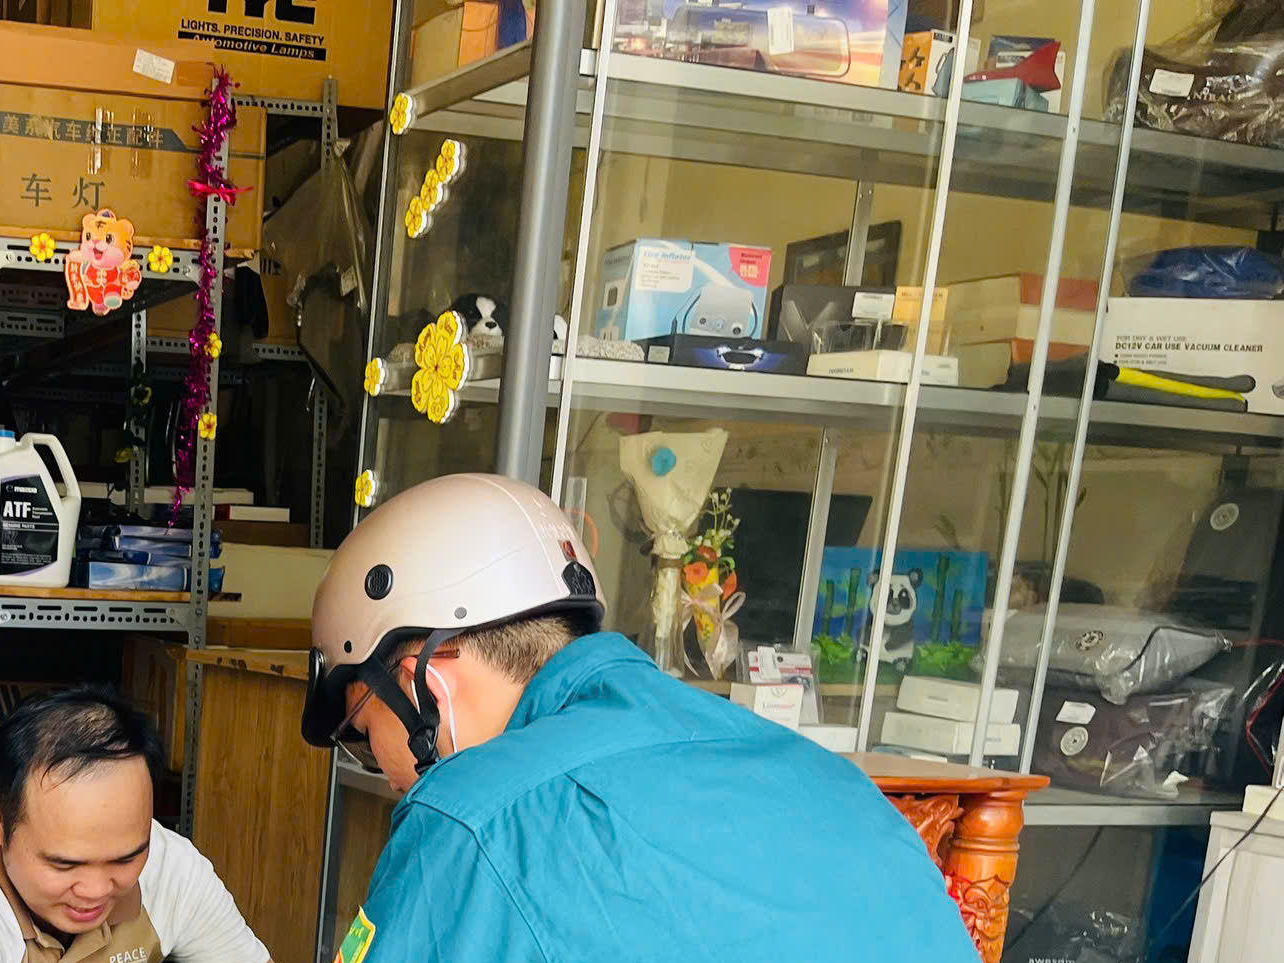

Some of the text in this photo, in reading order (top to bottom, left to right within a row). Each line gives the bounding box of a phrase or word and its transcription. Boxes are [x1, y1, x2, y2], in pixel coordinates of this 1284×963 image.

[181, 18, 324, 46] LIGHTS. PRECISION. SAFETY
[271, 43, 314, 59] Lamps
[20, 173, 105, 211] 车灯
[1115, 342, 1264, 353] DC12V CAR USE VACUUM CLEANER
[3, 501, 32, 518] ATF
